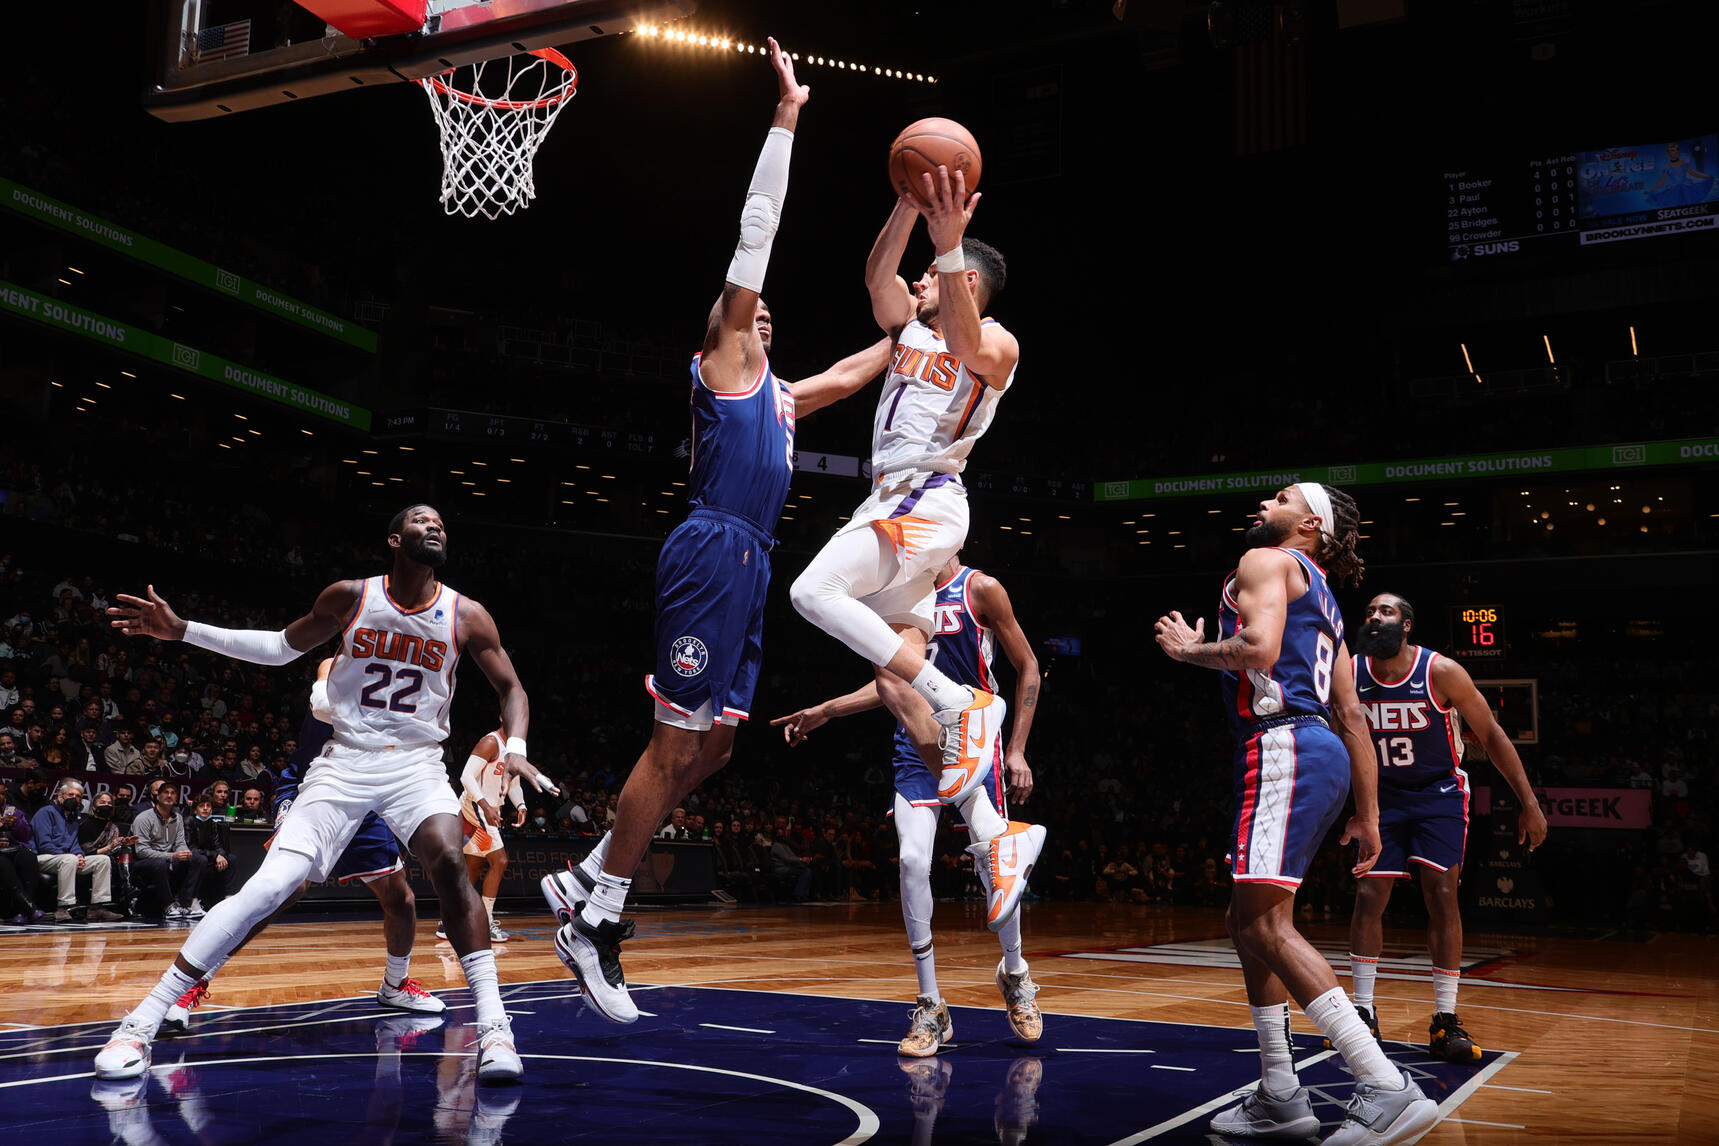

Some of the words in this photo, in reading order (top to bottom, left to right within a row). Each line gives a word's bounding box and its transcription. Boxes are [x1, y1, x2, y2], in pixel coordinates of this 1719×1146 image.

[1458, 179, 1492, 190] Booker
[1459, 194, 1480, 204] Paul
[13, 189, 73, 222] DOCUMENT
[76, 215, 134, 247] SOLUTIONS
[1460, 206, 1488, 216] Ayton
[1657, 204, 1709, 220] SEATGEEK
[1461, 218, 1498, 229] Bridges
[1586, 218, 1714, 242] BROOKLYNNETS.COM
[1462, 230, 1502, 241] Crowder
[1474, 241, 1520, 256] SUNS
[43, 302, 126, 342] SOLUTIONS
[256, 289, 300, 314] DOCUMENT
[301, 308, 344, 333] SOLUTIONS
[224, 365, 288, 399] DOCUMENT
[290, 388, 350, 420] SOLUTIONS
[884, 383, 906, 431] 1
[818, 456, 828, 470] 4
[1386, 460, 1464, 478] DOCUMENT
[1467, 455, 1552, 473] SOLUTIONS
[1154, 478, 1224, 494] DOCUMENT
[1226, 473, 1301, 488] SOLUTIONS
[1462, 609, 1497, 622] 10:06
[1472, 623, 1494, 645] 16
[352, 627, 448, 672] SUNS
[1314, 631, 1334, 705] 8
[360, 663, 424, 714] 22
[1360, 702, 1430, 730] NETS
[1378, 737, 1414, 766] 13
[1546, 796, 1622, 819] TGEEK
[1479, 896, 1536, 910] BARCLAYS
